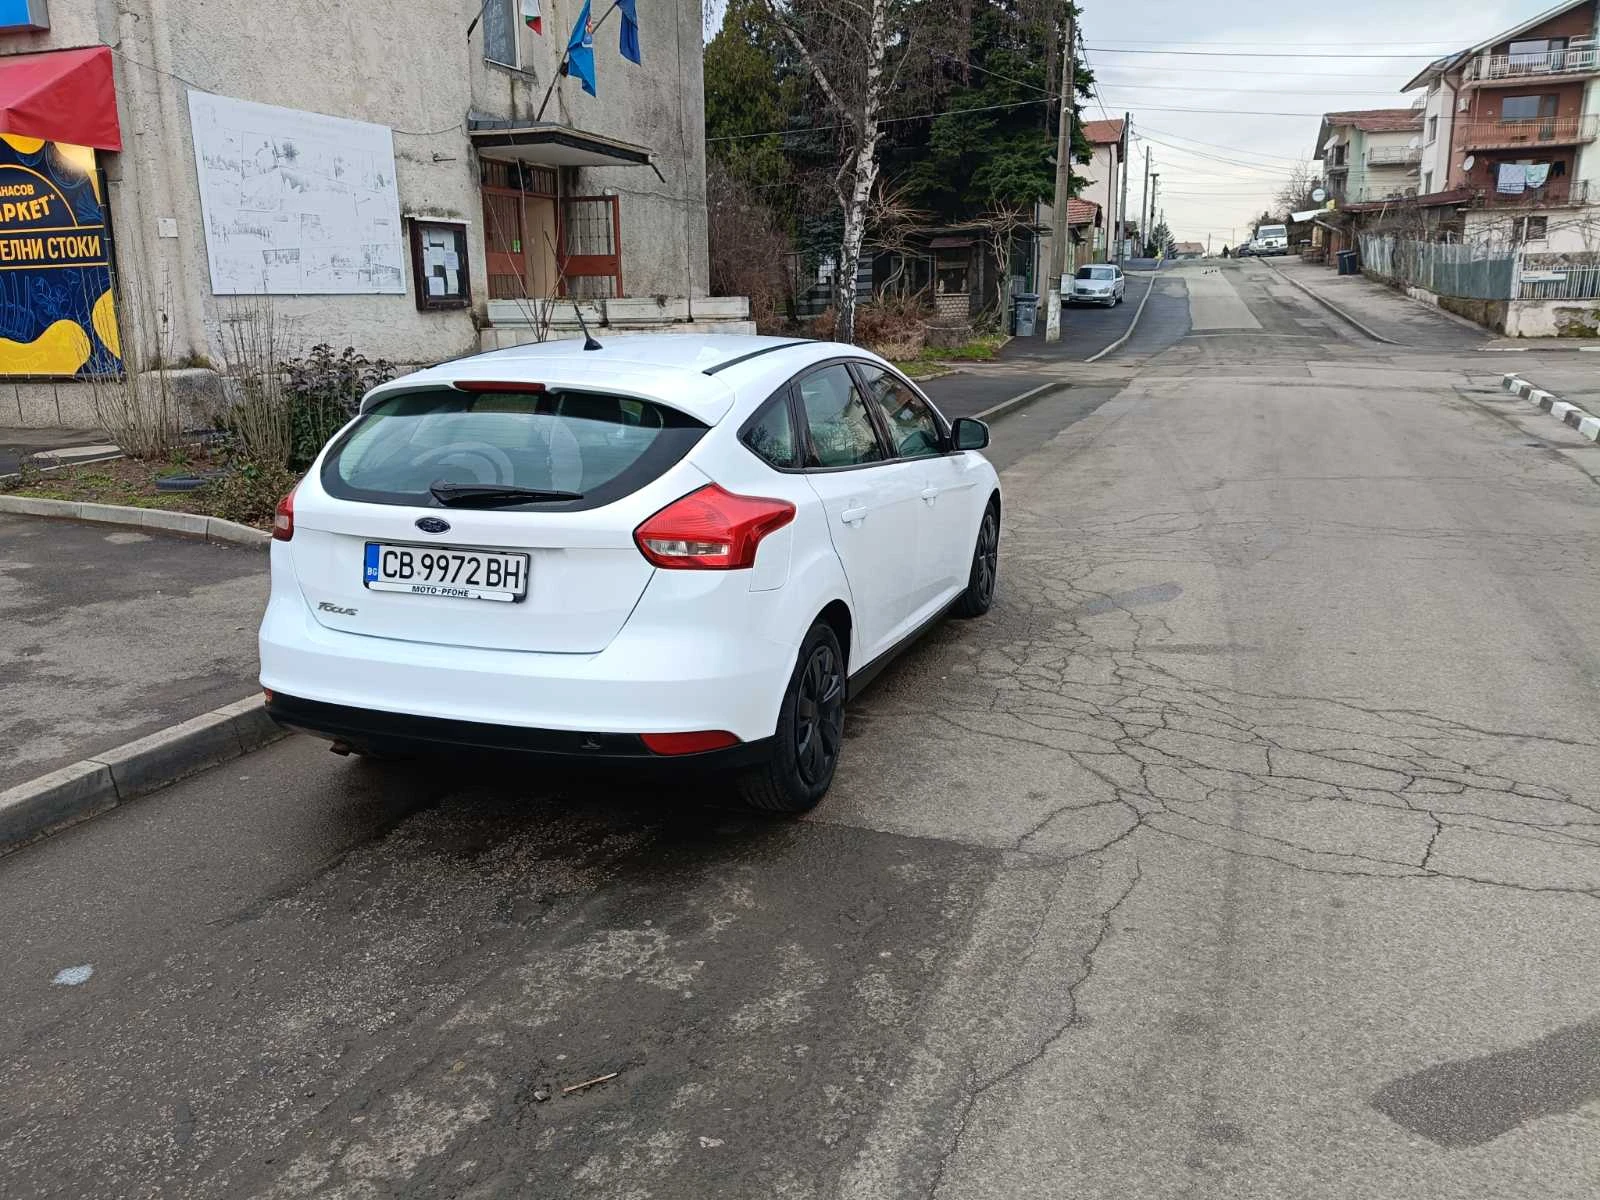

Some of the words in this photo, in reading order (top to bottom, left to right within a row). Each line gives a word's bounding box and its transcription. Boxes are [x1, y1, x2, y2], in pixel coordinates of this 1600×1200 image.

[47, 236, 101, 259] СТОКИ
[366, 567, 378, 576] BG
[420, 554, 481, 586] 9972
